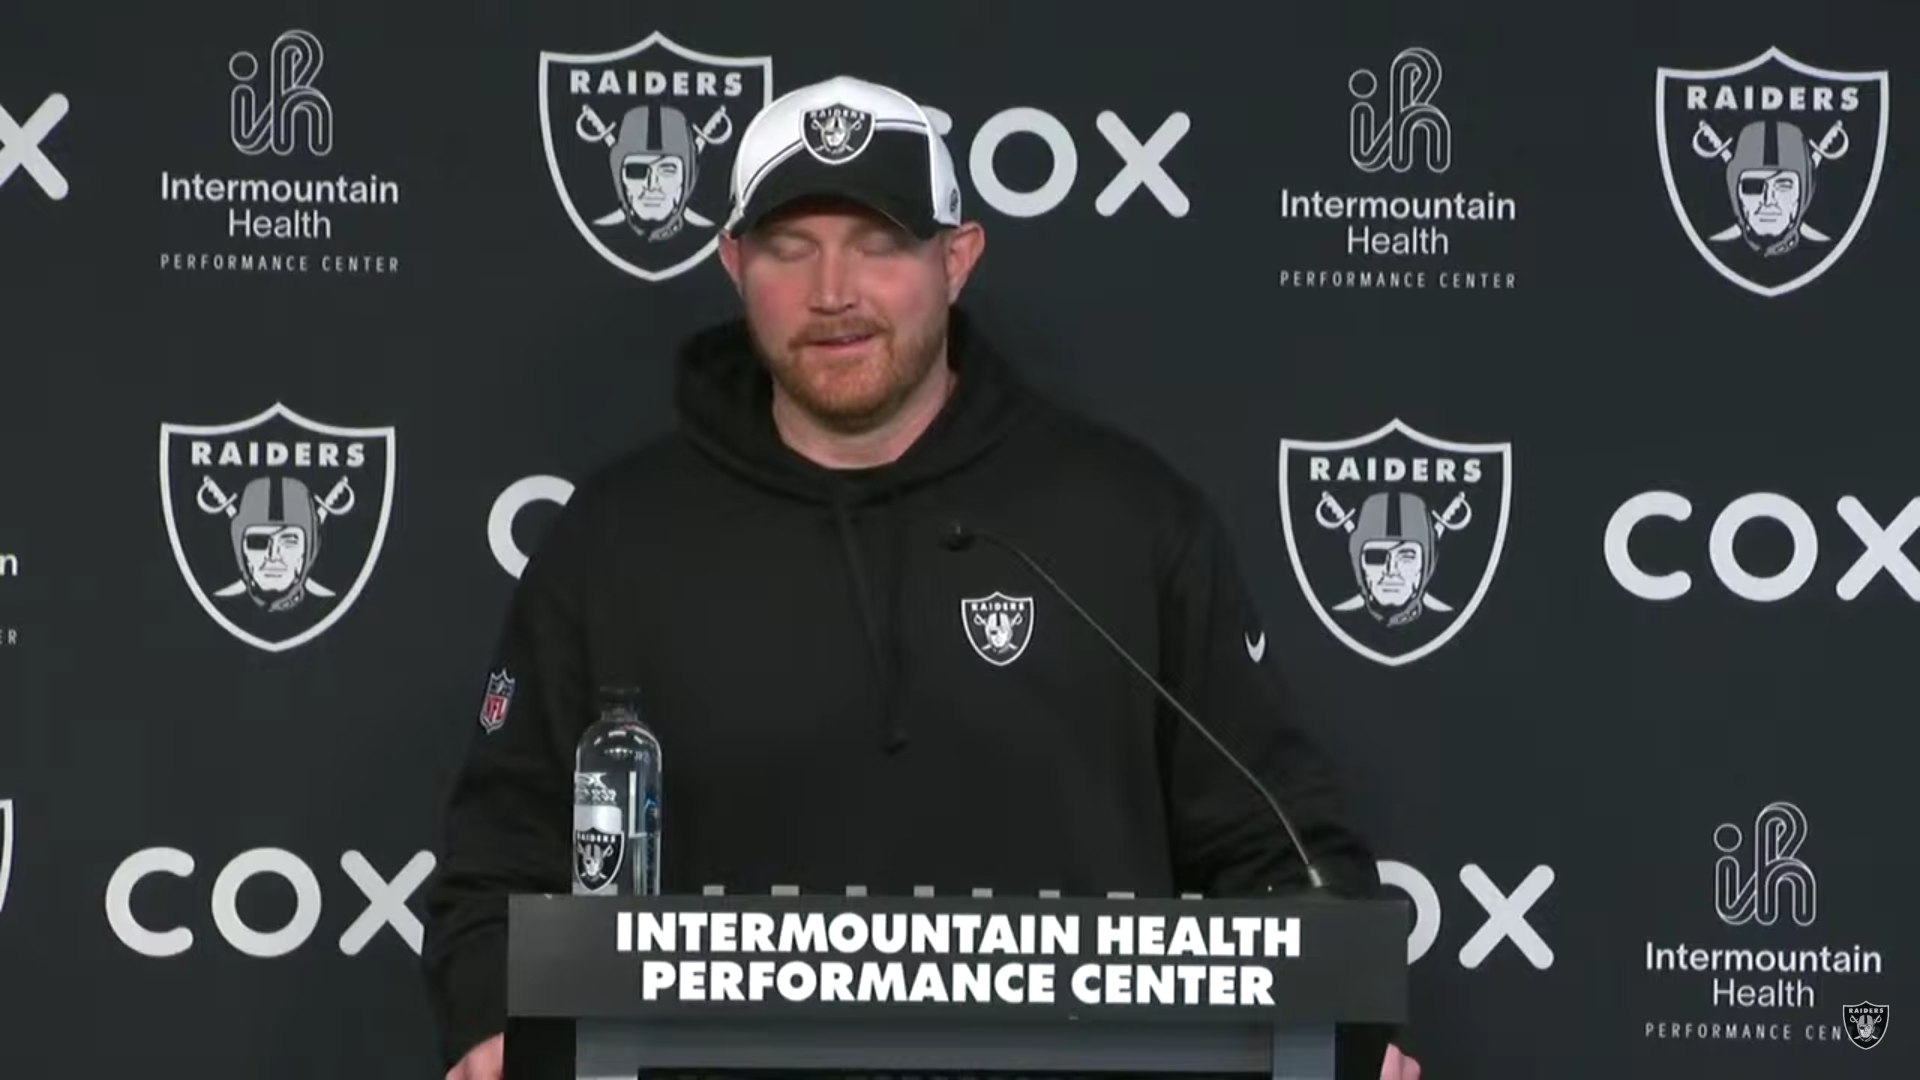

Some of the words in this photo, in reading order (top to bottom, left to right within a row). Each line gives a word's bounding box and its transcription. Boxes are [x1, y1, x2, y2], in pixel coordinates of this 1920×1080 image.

[571, 69, 743, 97] RAIDERS
[1687, 85, 1859, 112] RAIDERS
[919, 105, 1191, 218] OX
[161, 172, 399, 205] Intermountain
[1281, 189, 1516, 221] Intermountain
[228, 208, 332, 239] Health
[1346, 225, 1449, 256] Health
[161, 254, 308, 273] PERFORMANCE
[321, 255, 399, 273] CENTER
[1280, 271, 1425, 288] PERFORMANCE
[1439, 272, 1516, 289] CENTER
[191, 441, 366, 468] RAIDERS
[1310, 456, 1482, 483] RAIDERS
[1603, 490, 1920, 601] COX
[105, 846, 436, 958] COX
[616, 910, 1081, 956] INTERMOUNTAIN
[1096, 915, 1301, 958] HEALTH
[1645, 941, 1882, 973] Intermountain
[642, 960, 1056, 1004] PERFORMANCE
[1071, 963, 1275, 1006] CENTER
[1712, 977, 1816, 1008] Health
[1645, 1022, 1791, 1040] PERFORMANCE
